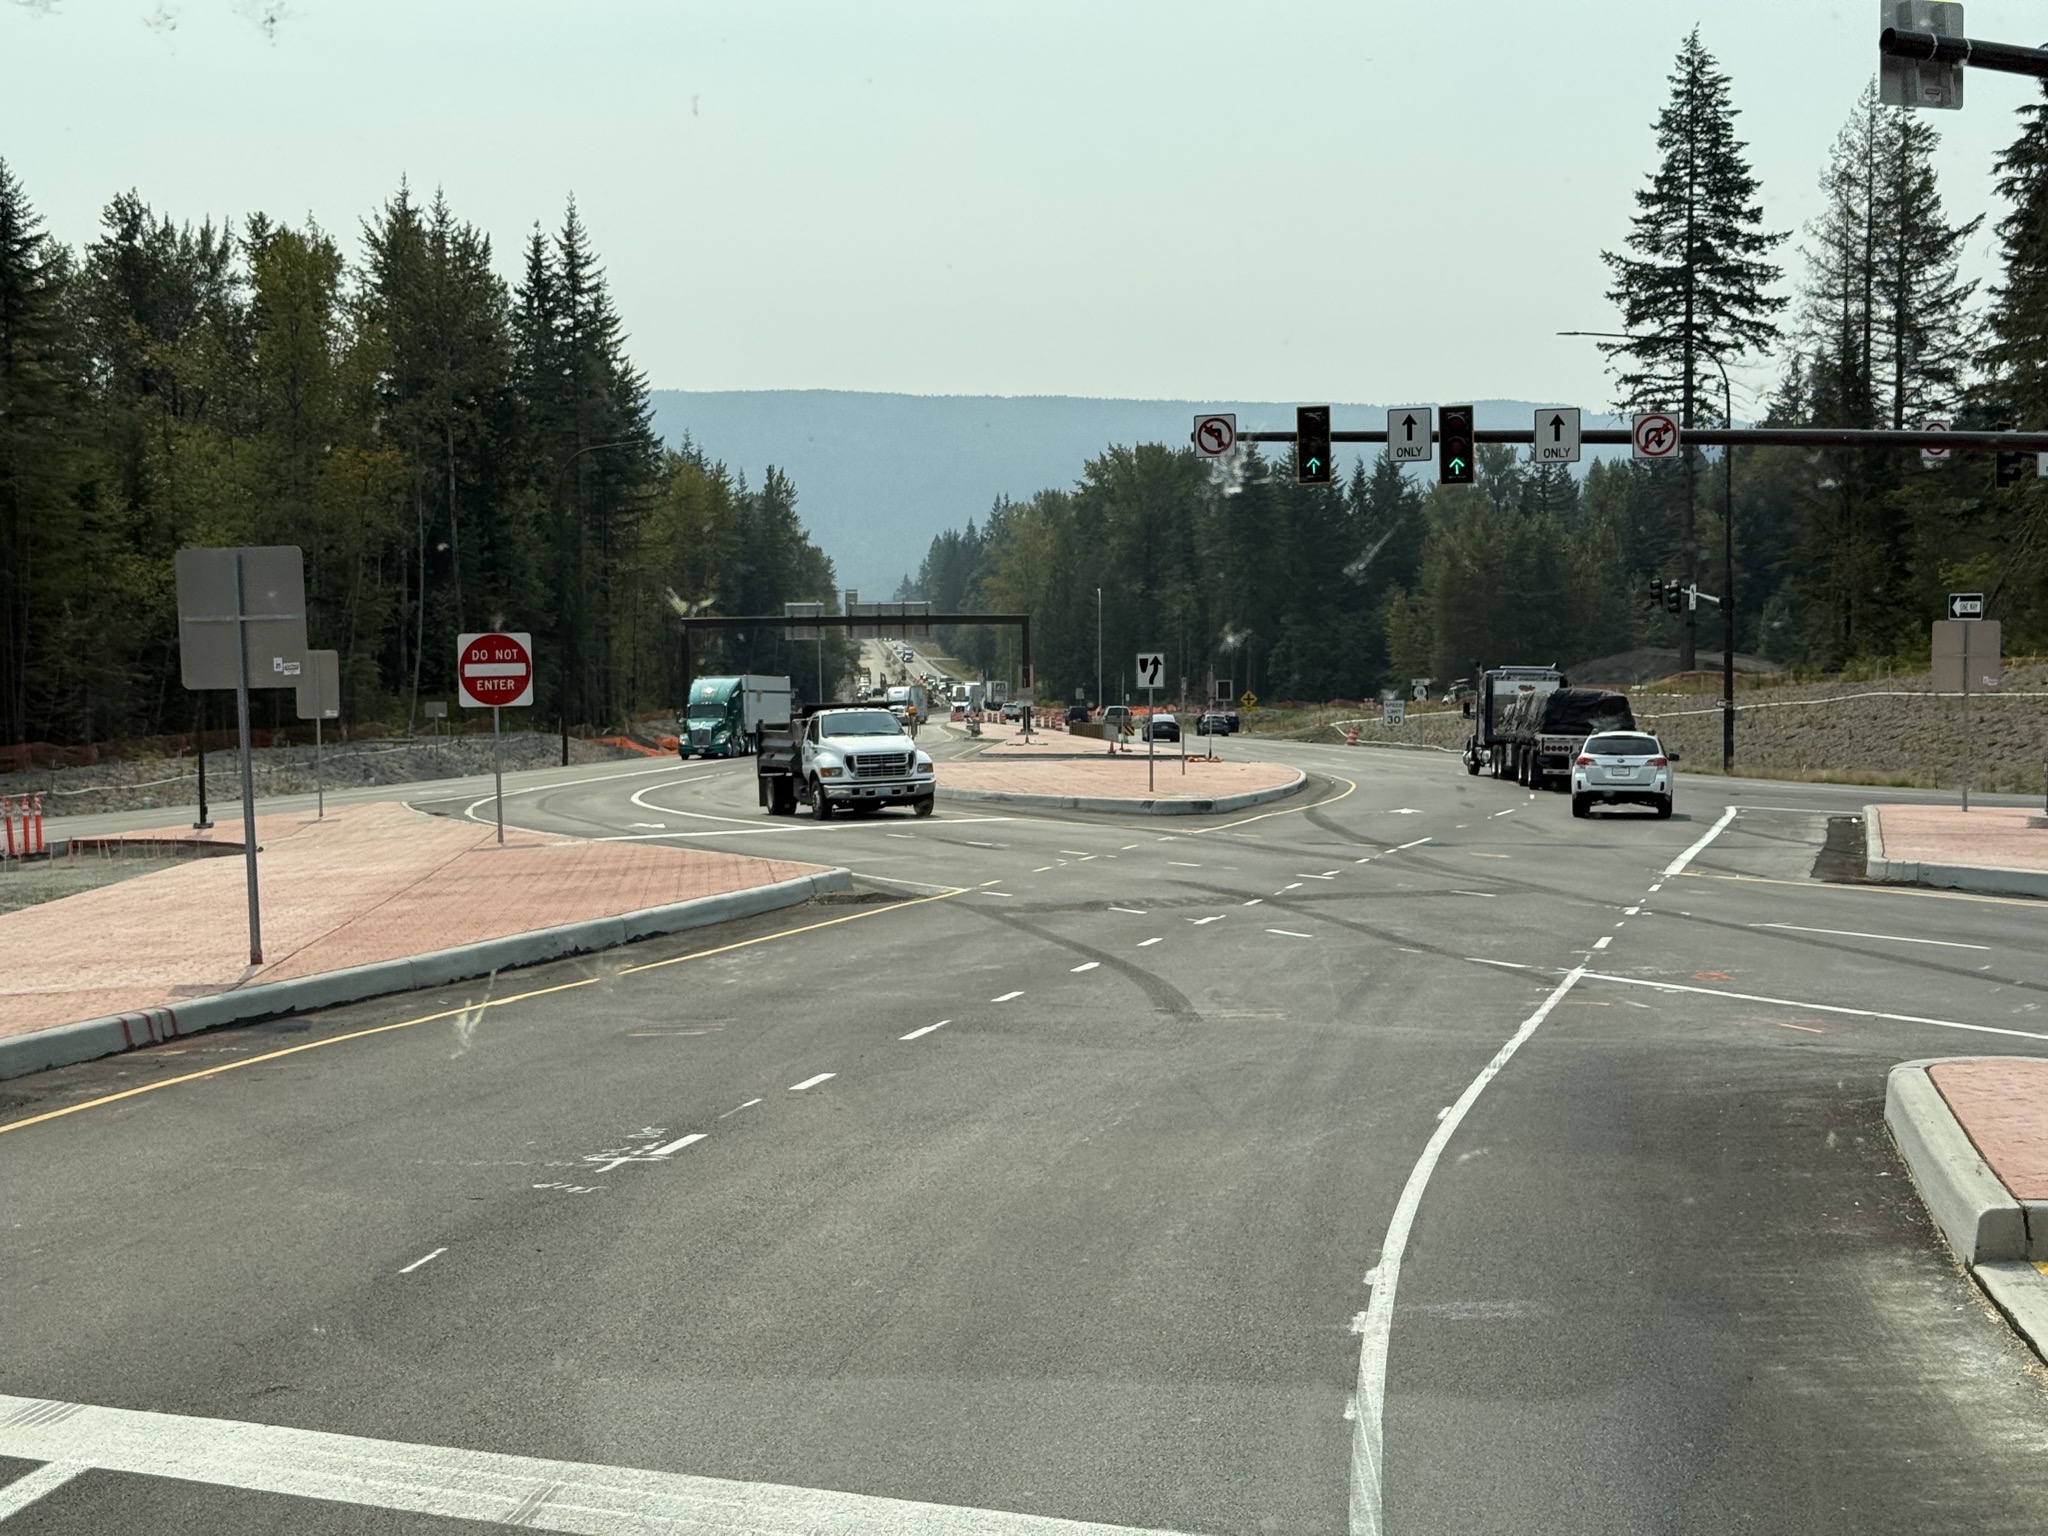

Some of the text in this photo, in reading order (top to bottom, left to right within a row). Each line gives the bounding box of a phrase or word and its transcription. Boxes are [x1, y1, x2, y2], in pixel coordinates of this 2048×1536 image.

[1396, 447, 1423, 458] ONLY
[1543, 447, 1570, 459] ONLY
[472, 649, 518, 660] DO NOT
[477, 679, 515, 691] ENTER
[1387, 715, 1401, 724] 30
